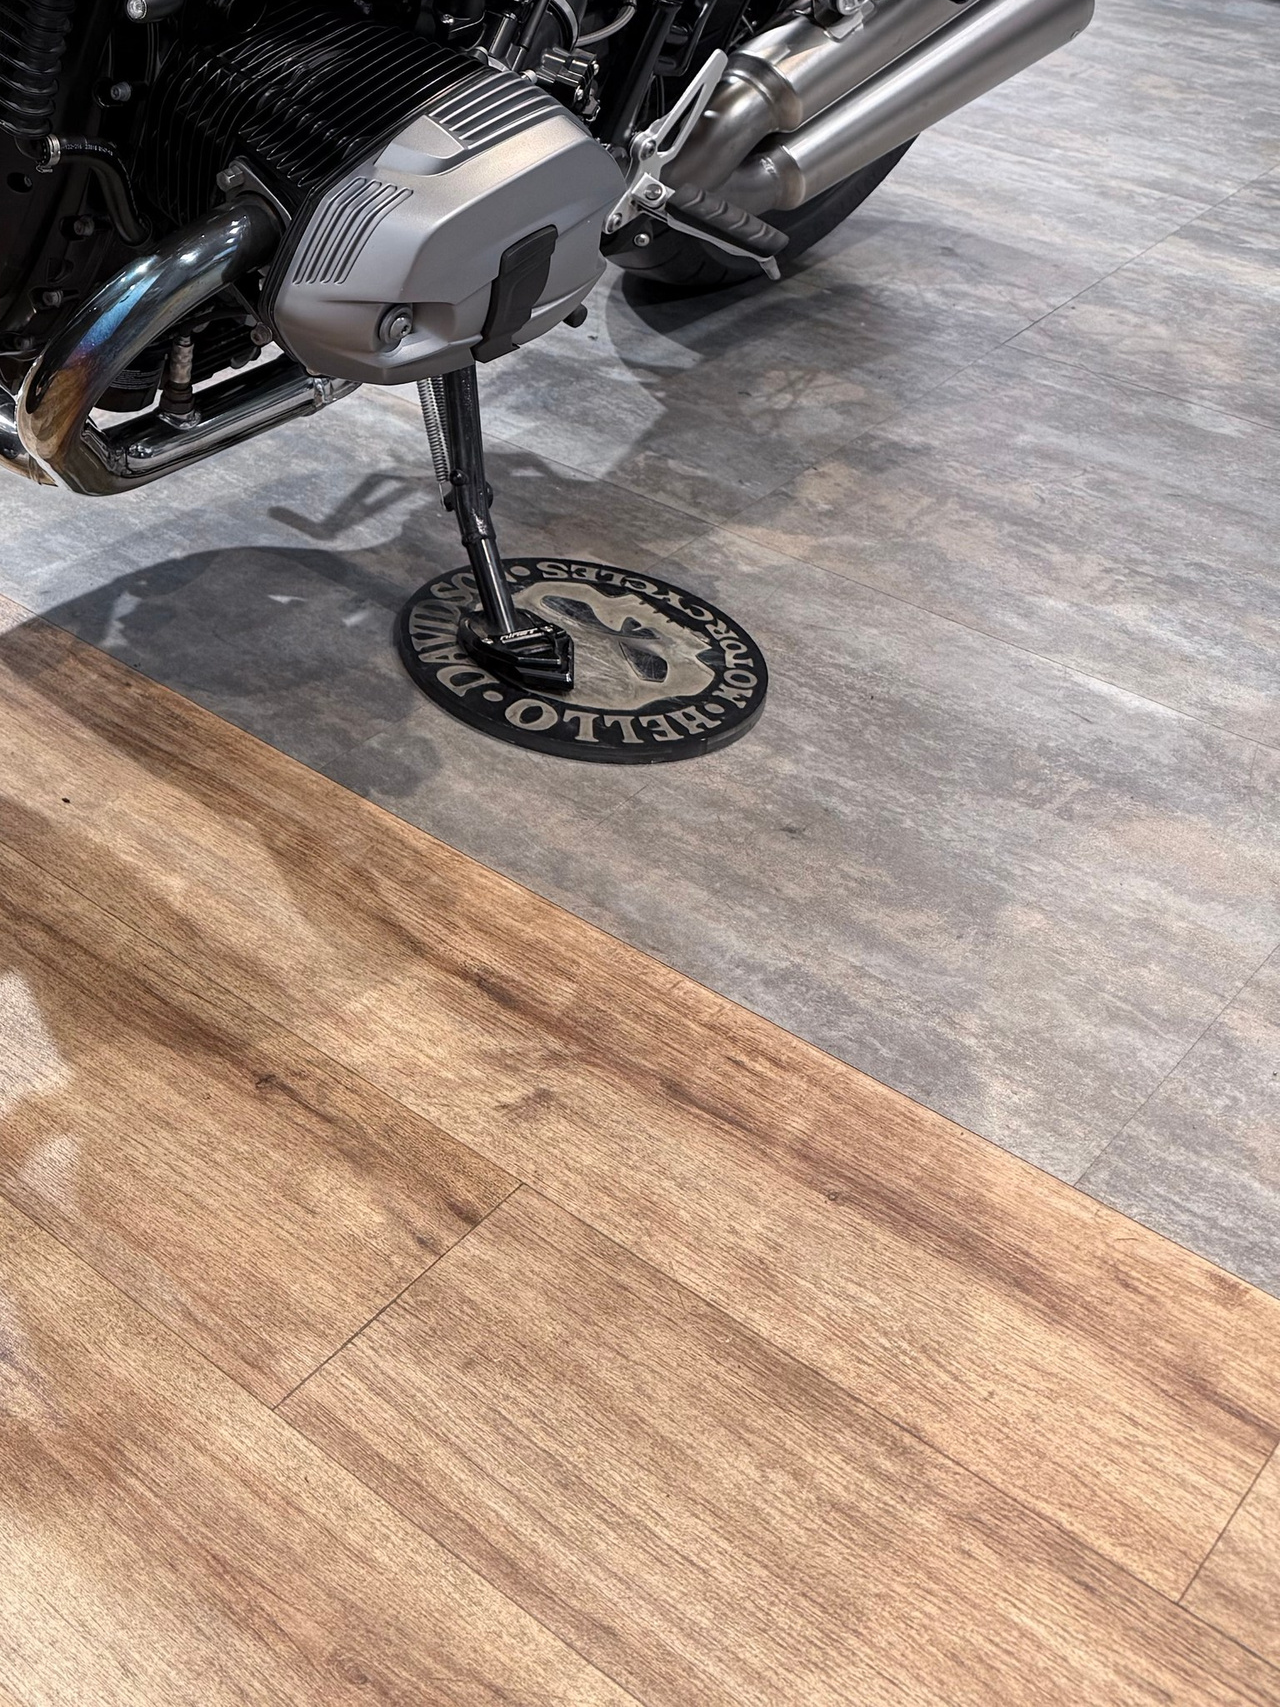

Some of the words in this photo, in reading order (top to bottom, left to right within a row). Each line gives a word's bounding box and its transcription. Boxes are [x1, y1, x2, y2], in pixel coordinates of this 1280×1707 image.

[408, 571, 517, 697] DAVIDSO
[538, 562, 758, 708] MOTORCYCLES
[505, 699, 721, 743] HELLO
